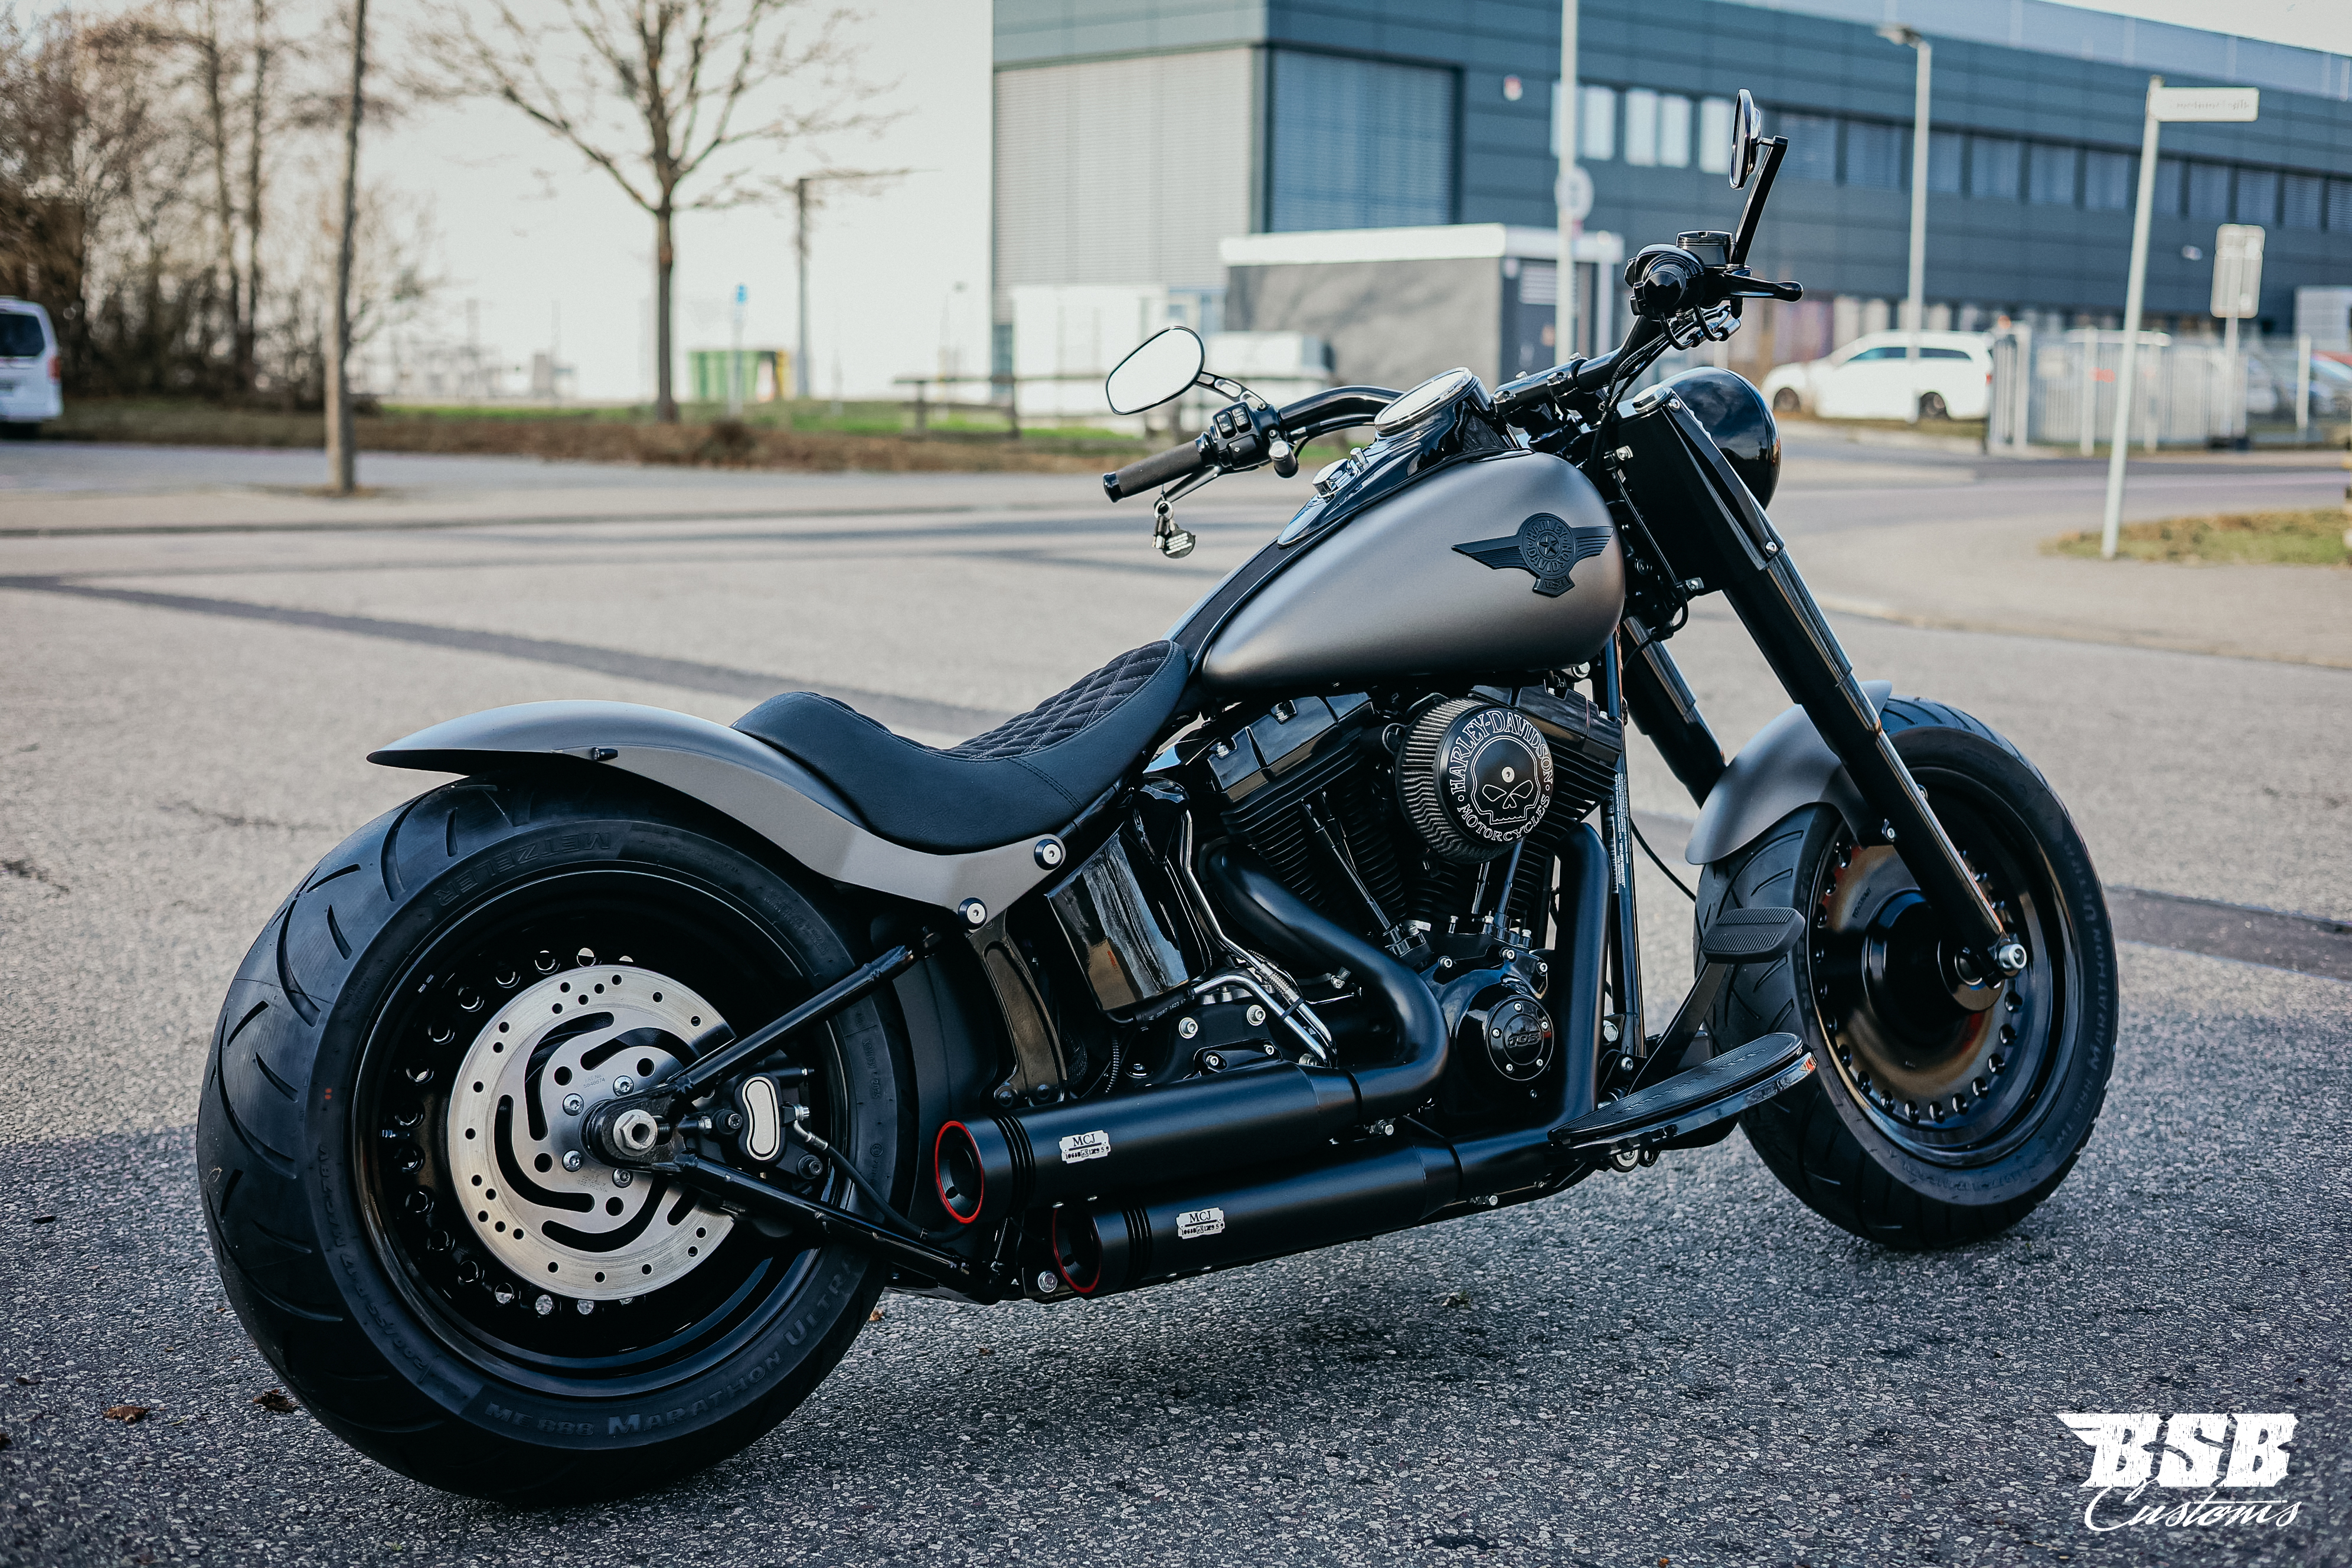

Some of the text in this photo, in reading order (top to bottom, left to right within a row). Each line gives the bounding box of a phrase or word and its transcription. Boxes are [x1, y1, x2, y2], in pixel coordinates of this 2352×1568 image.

[1525, 520, 1569, 542] HARLEY
[1525, 543, 1573, 573] DAVIDSON
[1449, 710, 1554, 795] HARLEY-DAVIDSON
[1457, 794, 1550, 842] MOTORCYCLES
[433, 832, 612, 907] METZELER
[2086, 927, 2109, 1072] MARATHON
[1507, 1030, 1541, 1048] 103
[1072, 1133, 1095, 1147] MCJ
[1189, 1210, 1211, 1223] MCJ
[484, 1400, 534, 1429] ME
[537, 1418, 595, 1436] 888
[607, 1350, 783, 1436] MARATHON
